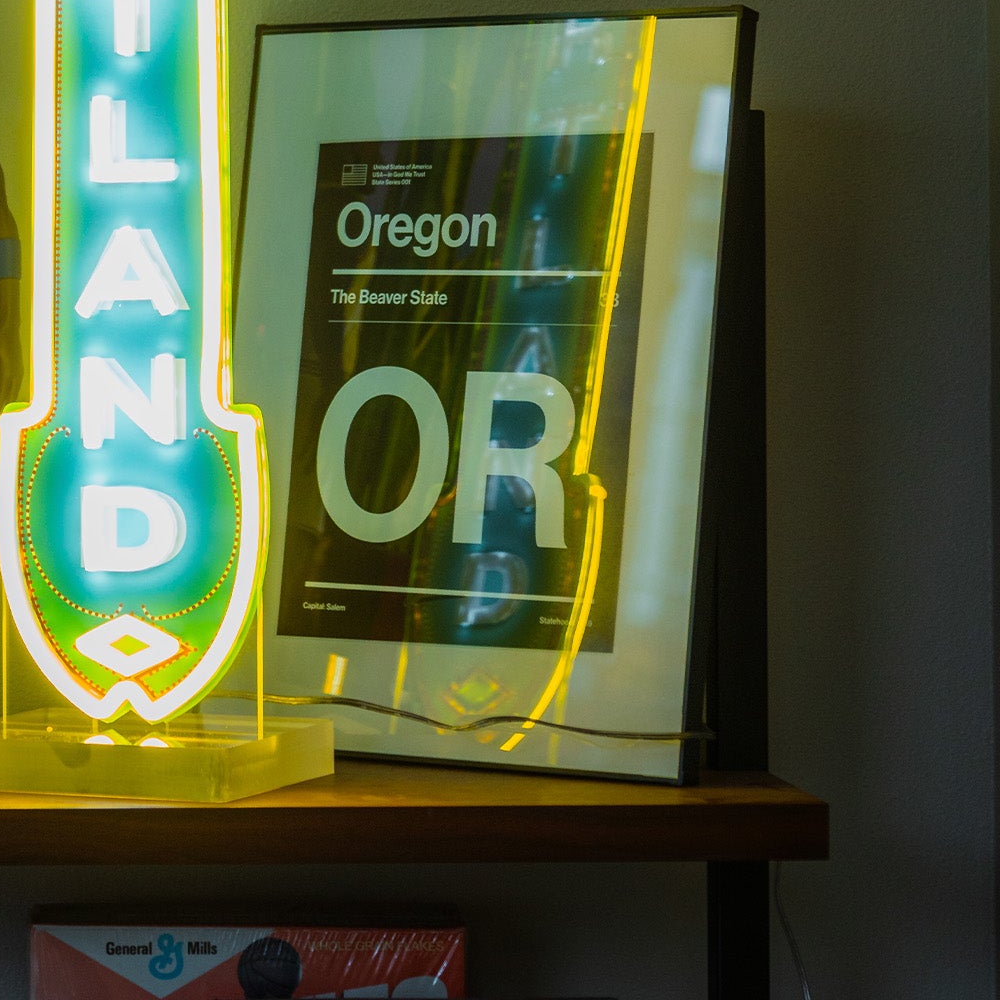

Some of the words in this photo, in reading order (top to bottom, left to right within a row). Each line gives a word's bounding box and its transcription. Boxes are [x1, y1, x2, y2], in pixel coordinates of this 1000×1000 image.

[337, 201, 497, 257] Oregon
[330, 289, 356, 304] The
[359, 290, 407, 305] Beaver
[410, 290, 448, 305] State
[316, 365, 576, 549] OR
[327, 603, 346, 612] Salem
[106, 941, 152, 955] General
[187, 941, 218, 955] Mills
